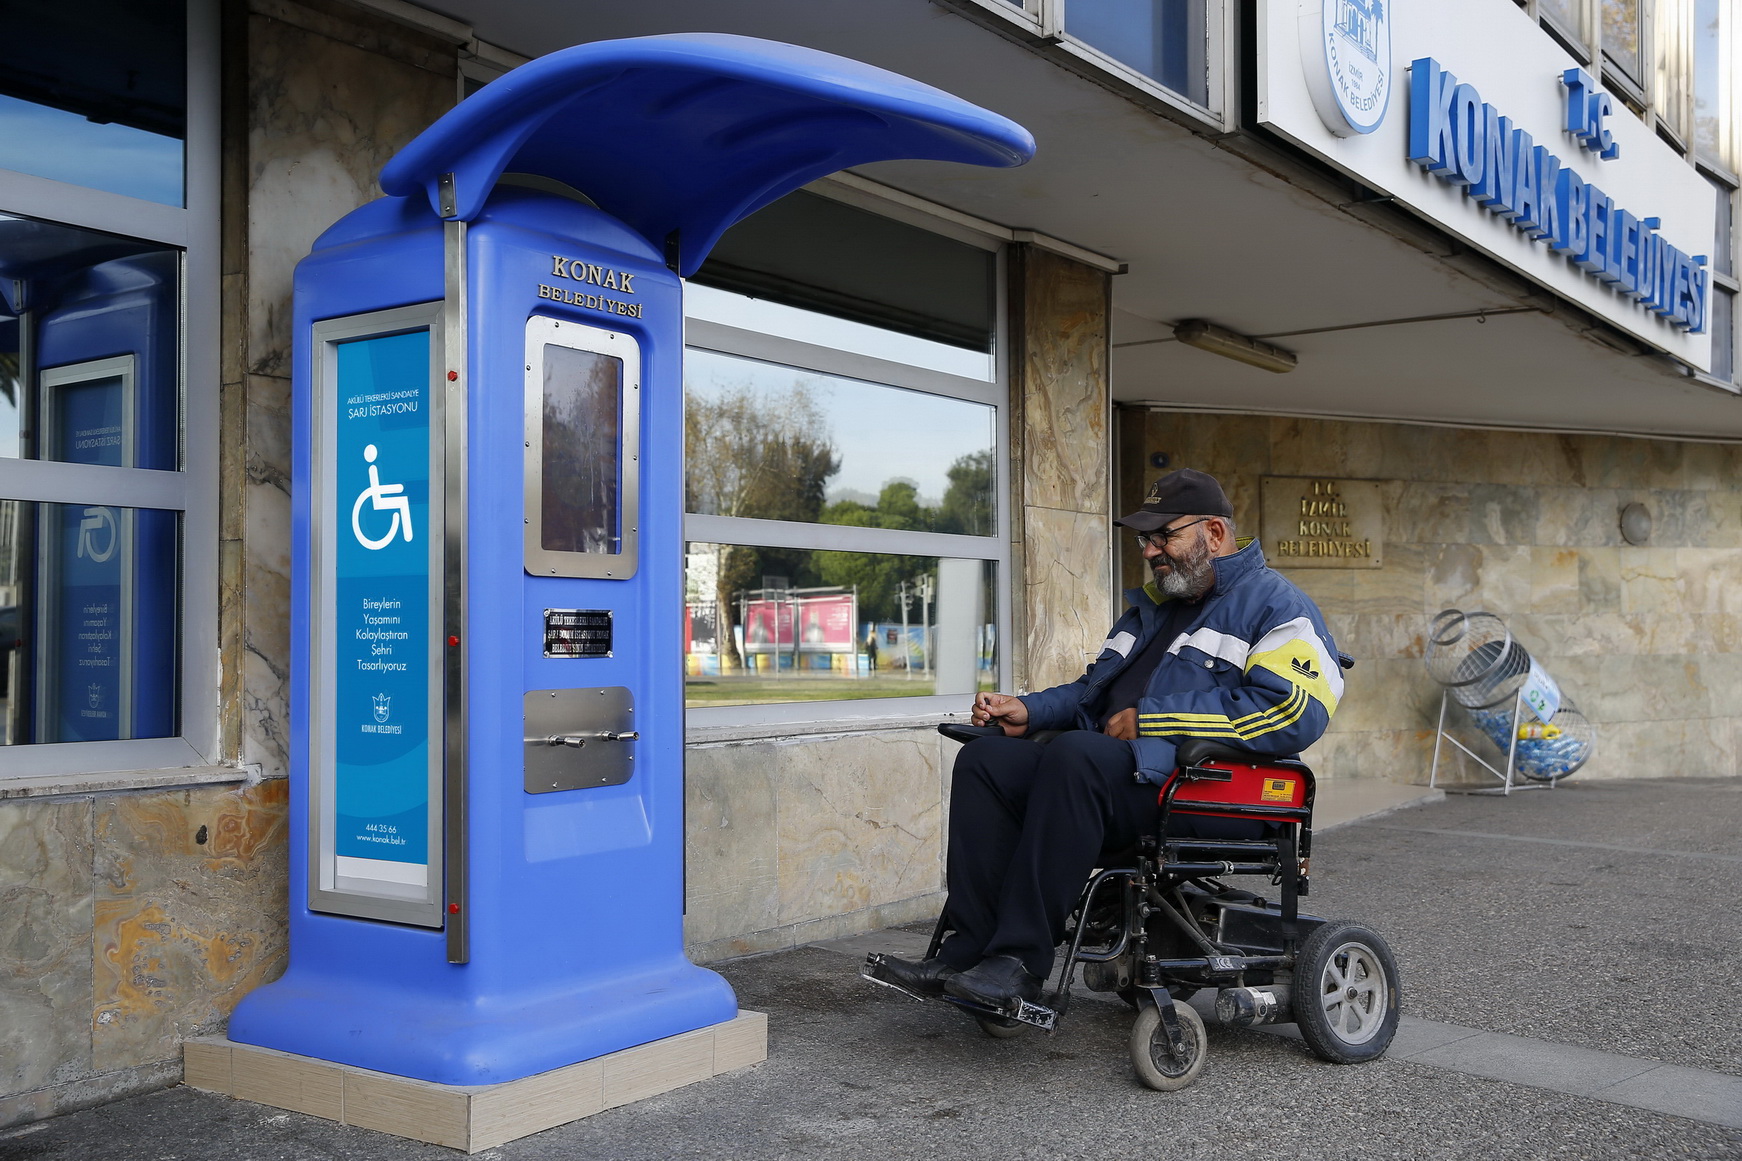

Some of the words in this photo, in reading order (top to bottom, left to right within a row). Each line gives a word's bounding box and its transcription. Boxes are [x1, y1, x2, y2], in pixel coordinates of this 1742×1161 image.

[1410, 57, 1560, 243] KONAK
[1552, 167, 1708, 334] BELEDİYESİ
[552, 255, 635, 294] KONAK
[538, 284, 643, 318] BELEDİYESİ
[348, 407, 368, 420] ŞARJ
[369, 401, 418, 416] İSTASYONU
[1298, 521, 1351, 537] KONAK
[1277, 538, 1371, 558] BELEDİYESİ
[363, 597, 401, 612] Bireylerin
[363, 613, 401, 626] Yaşamını
[355, 627, 409, 643] Kolaylaştıran
[371, 643, 393, 656] Şehri
[357, 658, 407, 674] Tasarlıyoruz
[366, 823, 378, 832] 444
[379, 824, 387, 833] 35
[388, 825, 397, 834] 66
[356, 833, 406, 845] www.konak.bel.tr
